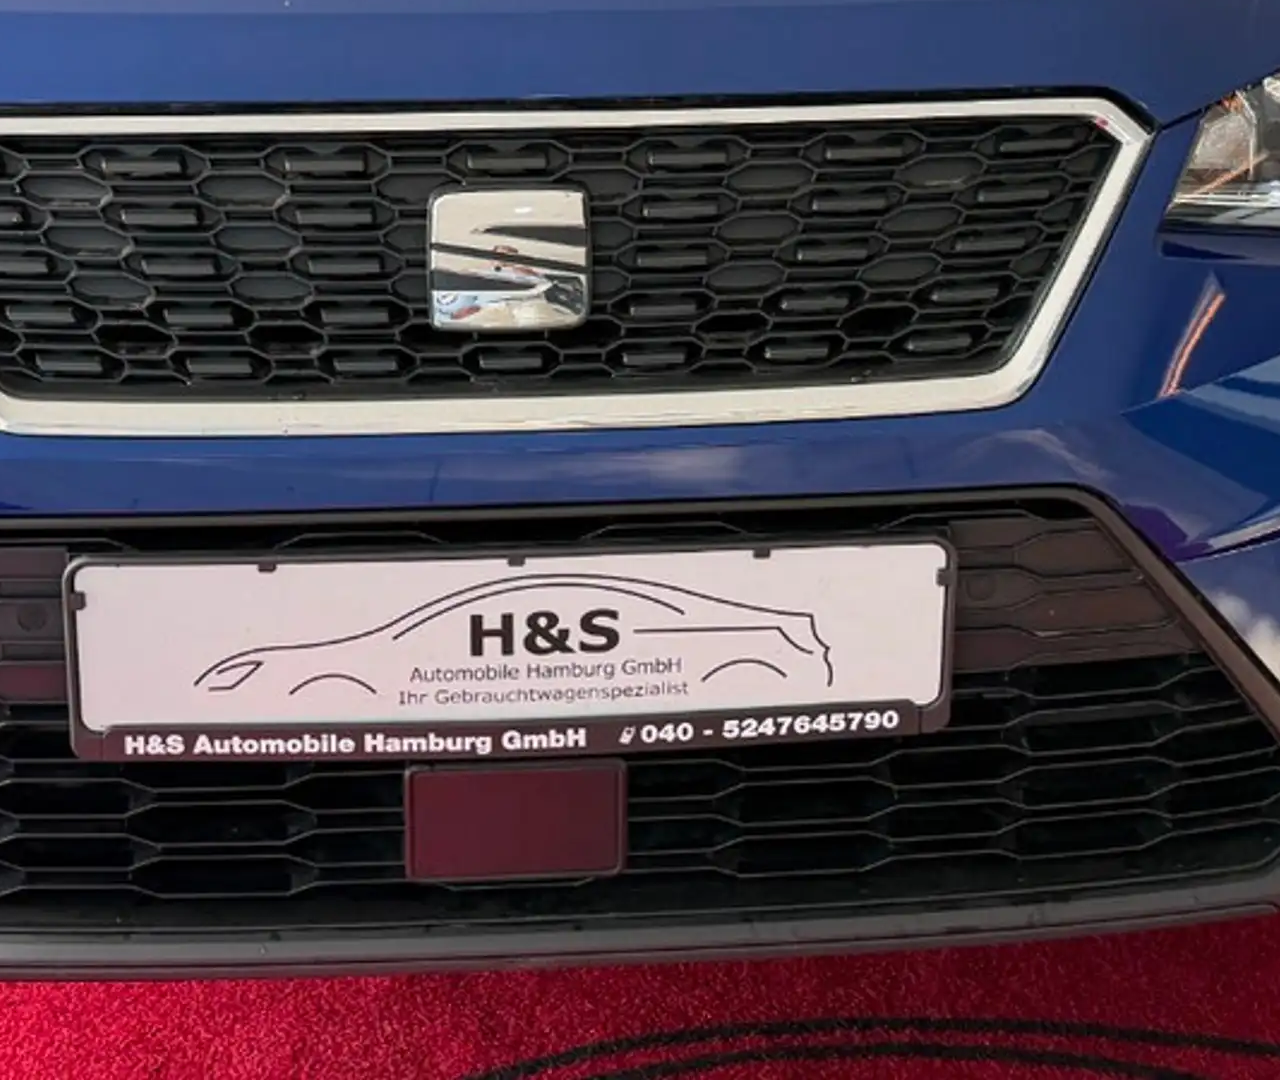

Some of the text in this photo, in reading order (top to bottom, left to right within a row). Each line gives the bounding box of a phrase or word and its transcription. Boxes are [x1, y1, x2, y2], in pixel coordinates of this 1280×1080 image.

[469, 608, 620, 656] H&S
[410, 656, 683, 683] Automobile Hamburg GmbH
[399, 680, 689, 705] Ihr Gebrauchtwagenspezialist
[124, 733, 185, 755] H&S
[193, 732, 356, 754] Automobile
[363, 731, 492, 754] Hamburg
[501, 728, 587, 751] GmbH
[640, 722, 694, 743] 040
[721, 710, 900, 739] 5247645790
